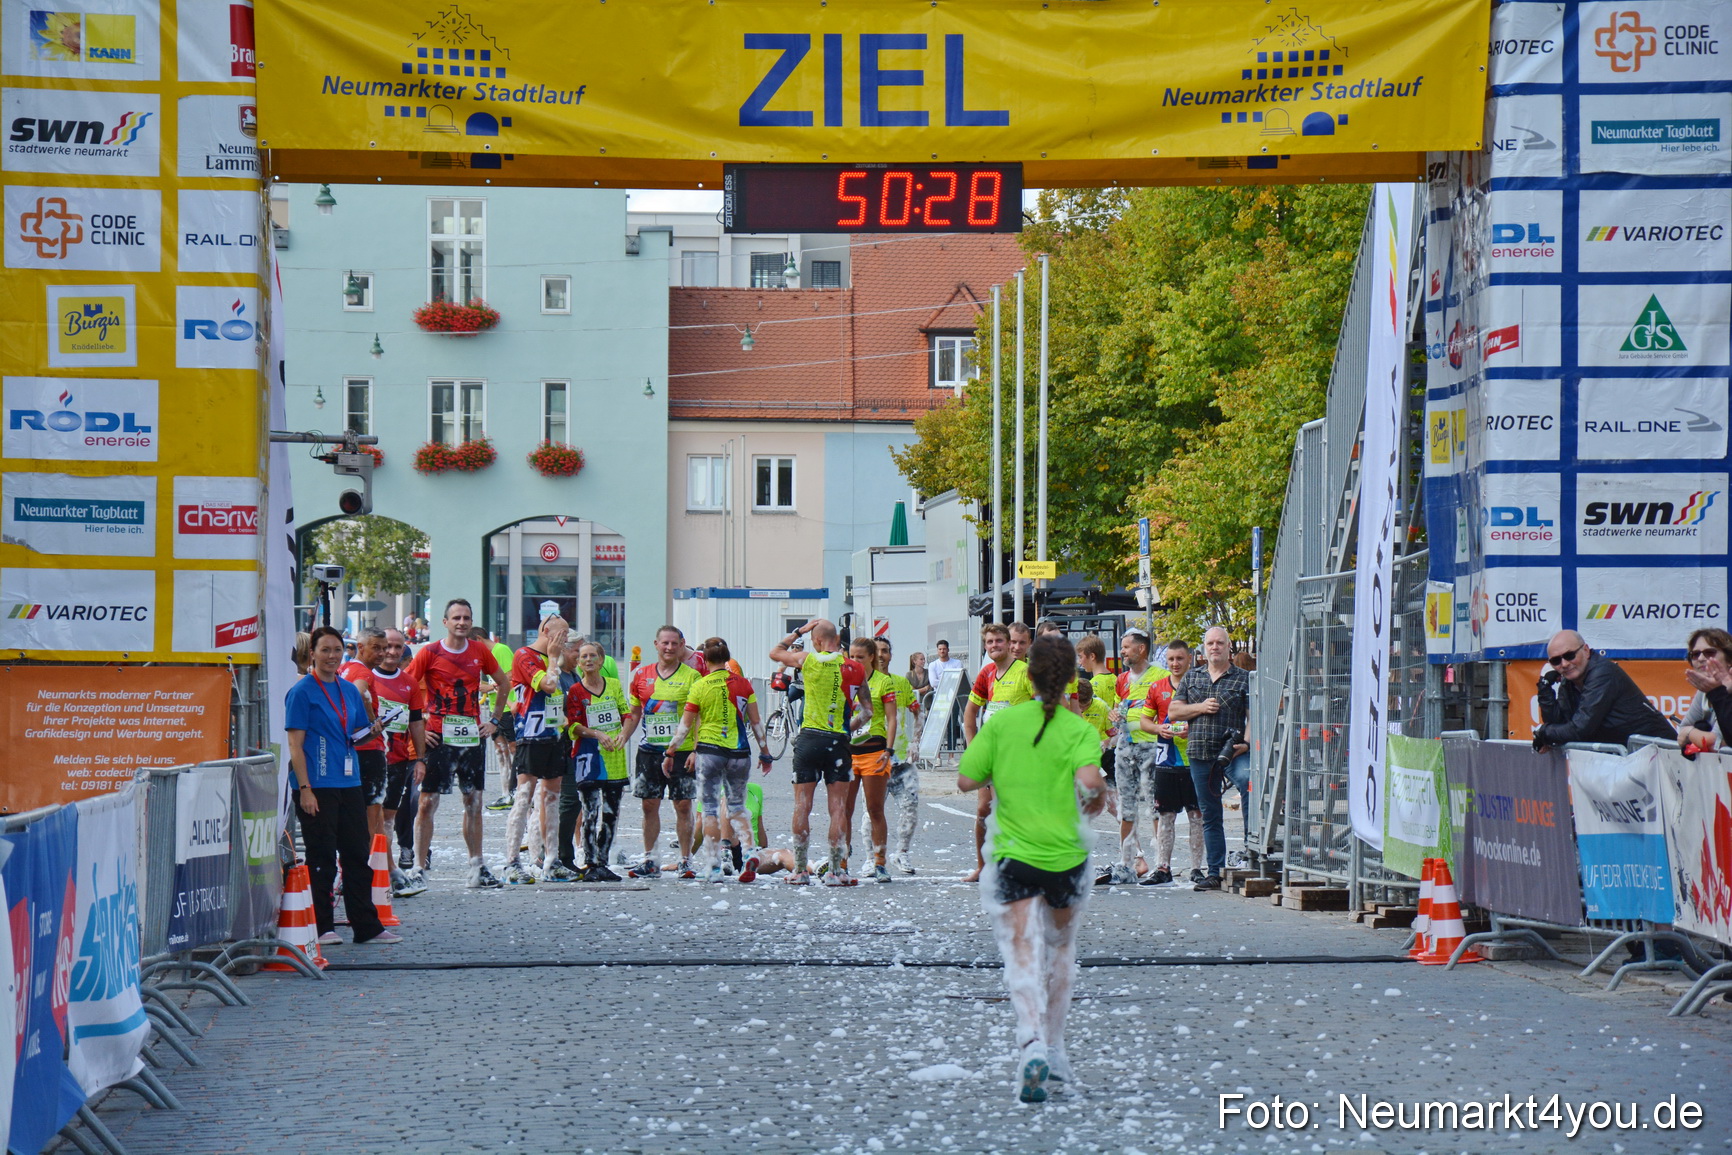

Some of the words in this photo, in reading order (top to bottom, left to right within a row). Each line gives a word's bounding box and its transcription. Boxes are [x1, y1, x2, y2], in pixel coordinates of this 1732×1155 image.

[1664, 25, 1711, 40] CODE
[89, 47, 131, 60] KANN
[1664, 41, 1719, 56] CLINIC
[738, 33, 1010, 128] ZIEL
[322, 75, 468, 101] Neumarkter
[473, 83, 587, 106] Stadtlauf
[1162, 79, 1305, 107] Neumarkter
[1310, 75, 1424, 102] Stadtlauf
[9, 118, 105, 145] swn
[1597, 125, 1664, 139] Neumarkter
[1665, 124, 1714, 139] Tagblatt
[8, 144, 72, 156] stadtwerke
[74, 147, 129, 158] neumarkt
[1660, 144, 1680, 153] Hier
[1682, 144, 1701, 152] lebe
[1703, 144, 1720, 152] ich.
[837, 171, 1003, 226] 50:28
[90, 214, 137, 230] CODE
[90, 230, 145, 246] CLINIC
[1623, 225, 1723, 242] VARIOTEC
[1491, 245, 1555, 258] energie
[64, 311, 120, 342] Burgis
[84, 432, 151, 448] energie
[20, 502, 88, 521] Neumarkter
[89, 504, 139, 521] Tagblatt
[1584, 502, 1675, 526] swn
[84, 524, 105, 534] Hier
[106, 525, 127, 534] lebe
[128, 525, 145, 535] ich.
[1490, 525, 1554, 541] energie
[1582, 527, 1643, 538] stadtwerke
[1644, 527, 1698, 537] neumarkt
[1495, 593, 1539, 607] CODE
[46, 604, 148, 622] VARIOTEC
[1495, 608, 1547, 622] CLINIC
[1622, 603, 1720, 620] VARIOTEC
[37, 690, 97, 700] Neumarkts
[99, 690, 151, 700] moderner
[153, 690, 194, 700] Partner
[26, 703, 43, 713] für
[45, 703, 61, 713] die
[63, 703, 122, 715] Konzeption
[123, 703, 143, 713] und
[146, 703, 205, 715] Umsetzung
[43, 716, 69, 726] Ihrer
[71, 716, 116, 727] Projekte
[118, 718, 140, 726] was
[531, 714, 543, 734] 7
[598, 712, 612, 723] 88
[25, 729, 91, 741] Grafikdesign
[93, 729, 114, 739] und
[116, 729, 163, 741] Werbung
[165, 730, 205, 742] angeht.
[454, 727, 469, 736] 58
[653, 725, 672, 735] 181
[53, 754, 93, 765] Melden
[94, 754, 110, 765] Sie
[112, 755, 133, 765] sich
[135, 755, 152, 765] bei
[153, 756, 176, 765] uns:
[1157, 746, 1164, 762] 7
[67, 768, 92, 777] web:
[578, 757, 588, 777] 7
[60, 781, 78, 791] tel:
[80, 781, 112, 791] 09181
[1515, 797, 1557, 828] LOUNGE
